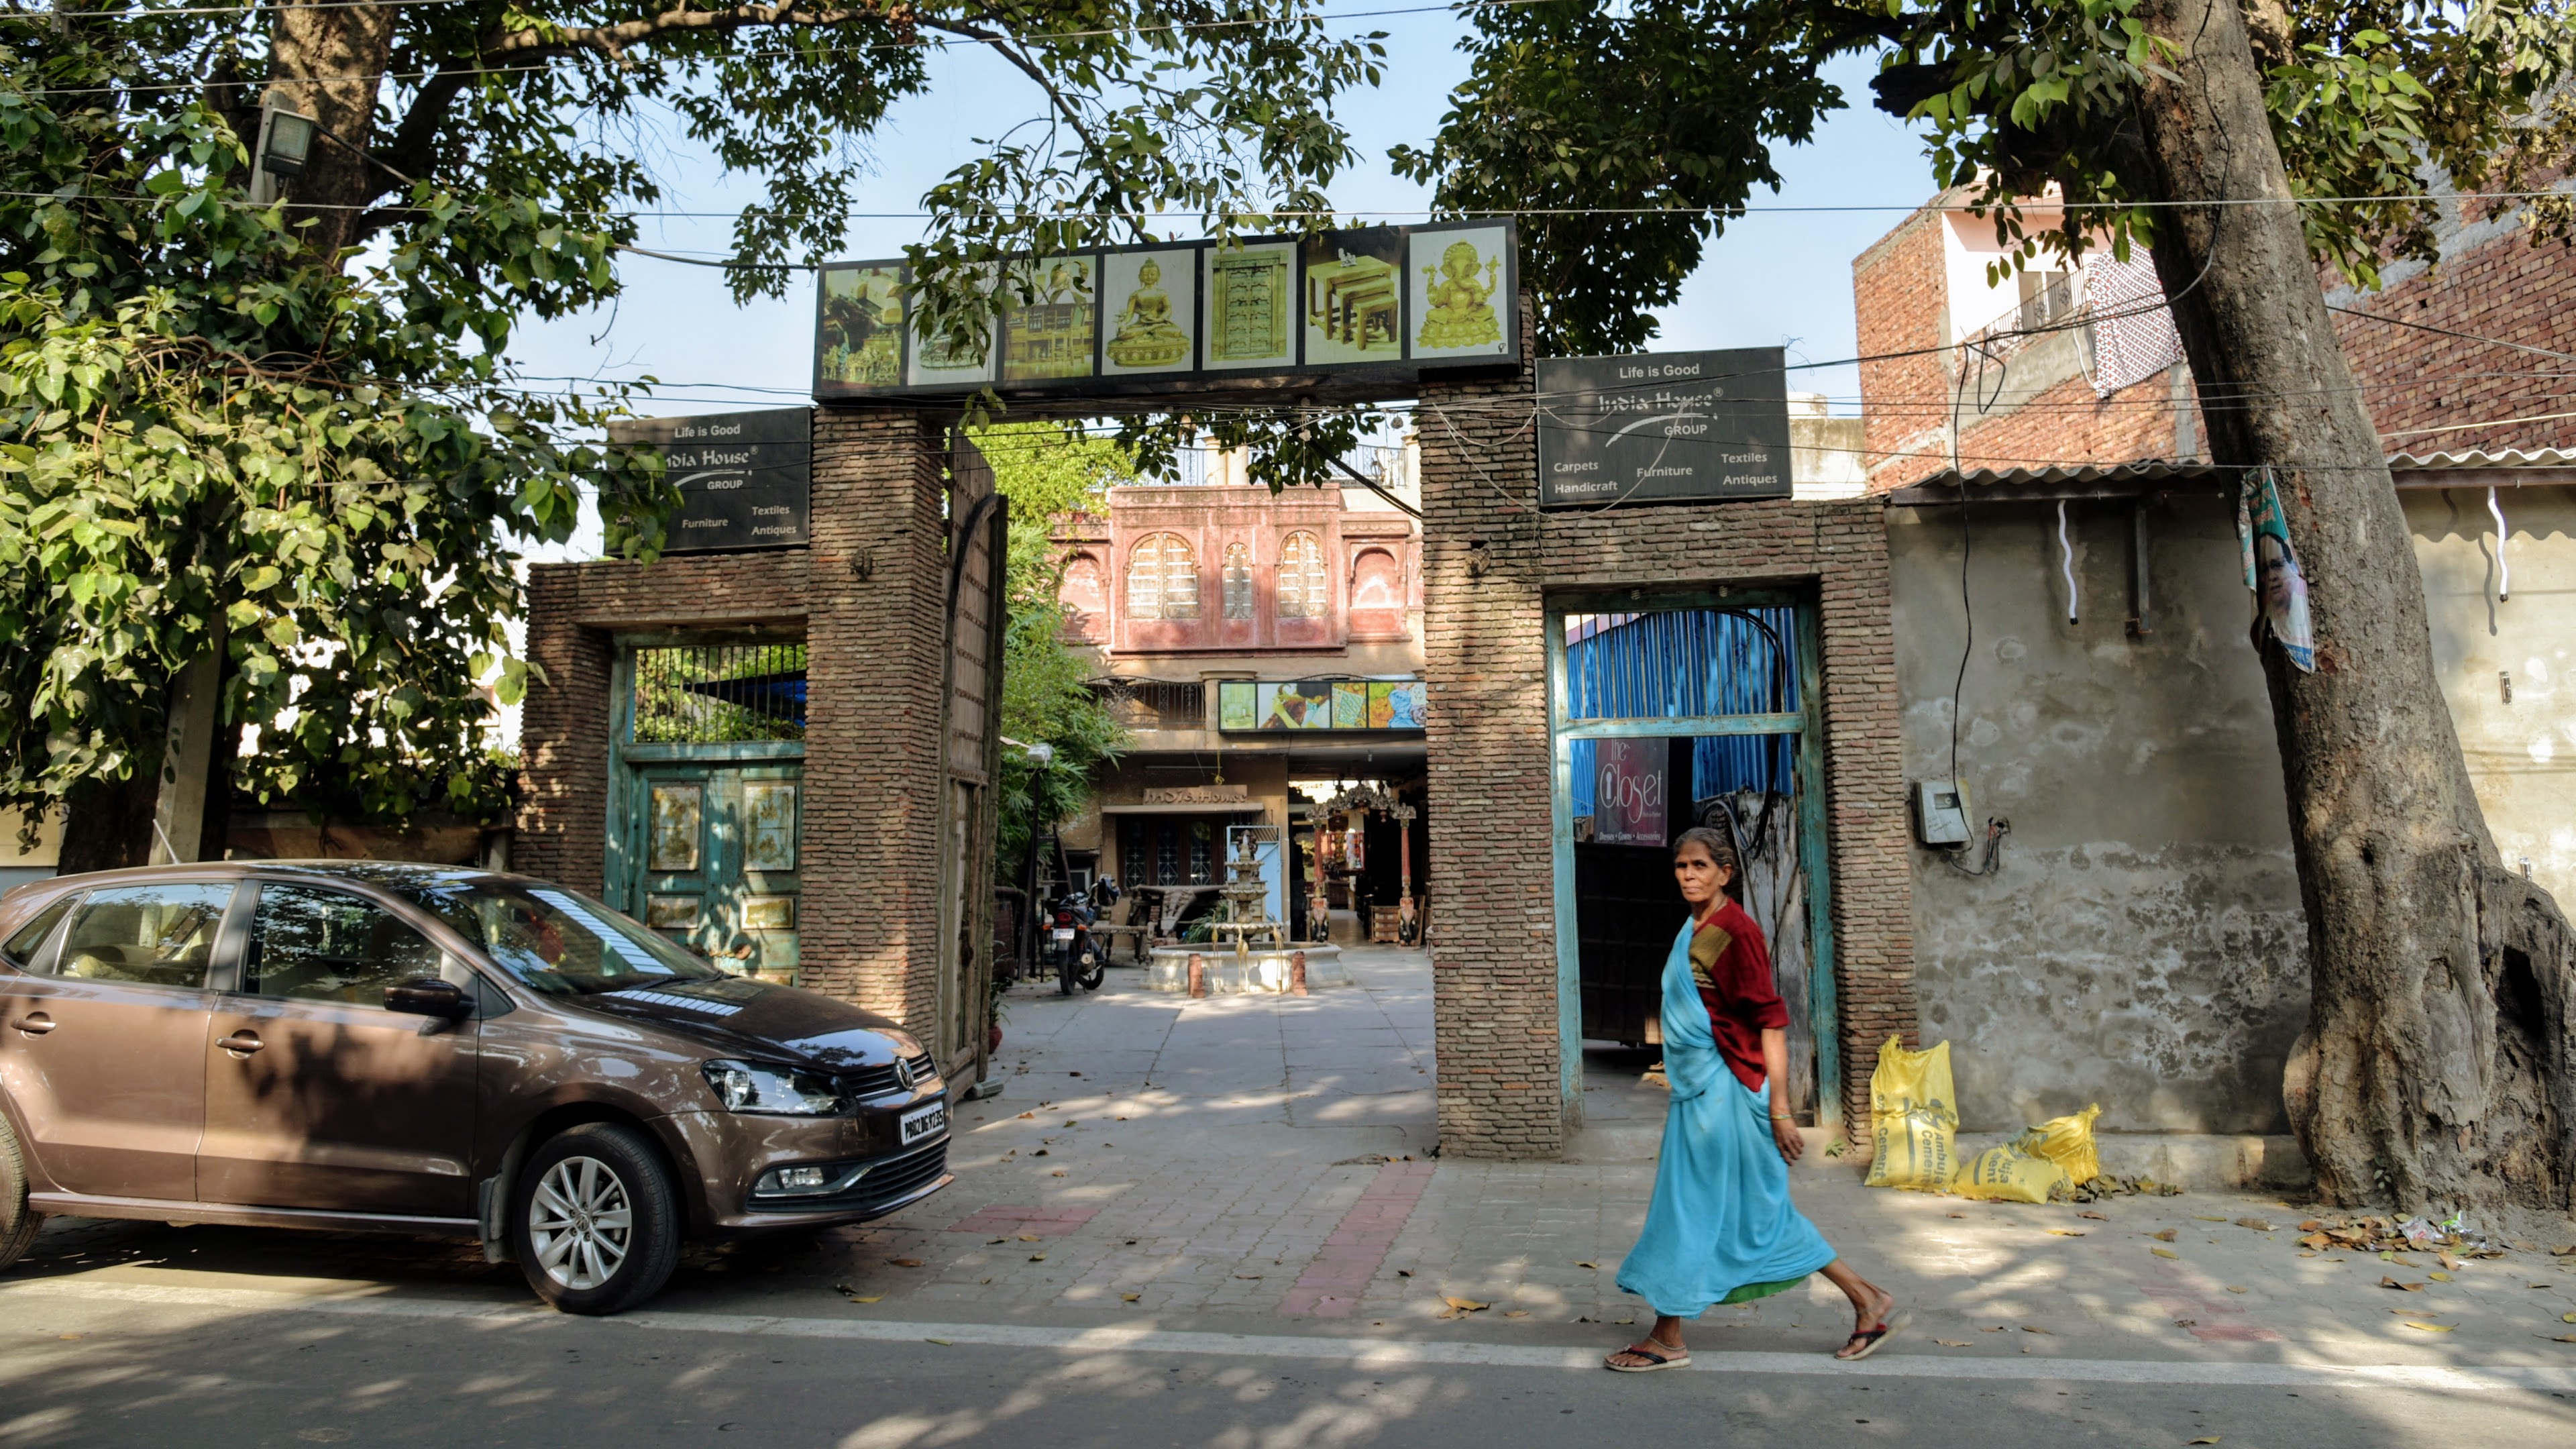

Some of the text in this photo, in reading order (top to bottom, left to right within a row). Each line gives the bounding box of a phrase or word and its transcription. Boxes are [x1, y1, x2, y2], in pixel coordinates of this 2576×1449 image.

[1619, 363, 1700, 379] Life is Good
[1599, 394, 1650, 413] India
[1655, 391, 1713, 409] House
[674, 423, 741, 438] Life is Good
[1664, 424, 1707, 436] GROUP
[702, 449, 749, 466] House
[1721, 453, 1768, 464] Textiles
[1554, 460, 1599, 473] Carpets
[1636, 466, 1693, 478] Furniture
[707, 480, 743, 490] GROUP
[1723, 473, 1778, 487] Antiques
[1554, 480, 1618, 494] Handicraft
[752, 505, 790, 517] Textiles
[682, 517, 729, 529] Furniture
[751, 525, 797, 537] Antiques
[1921, 1130, 1934, 1185] Cement
[1933, 1132, 1948, 1185] Ambuja
